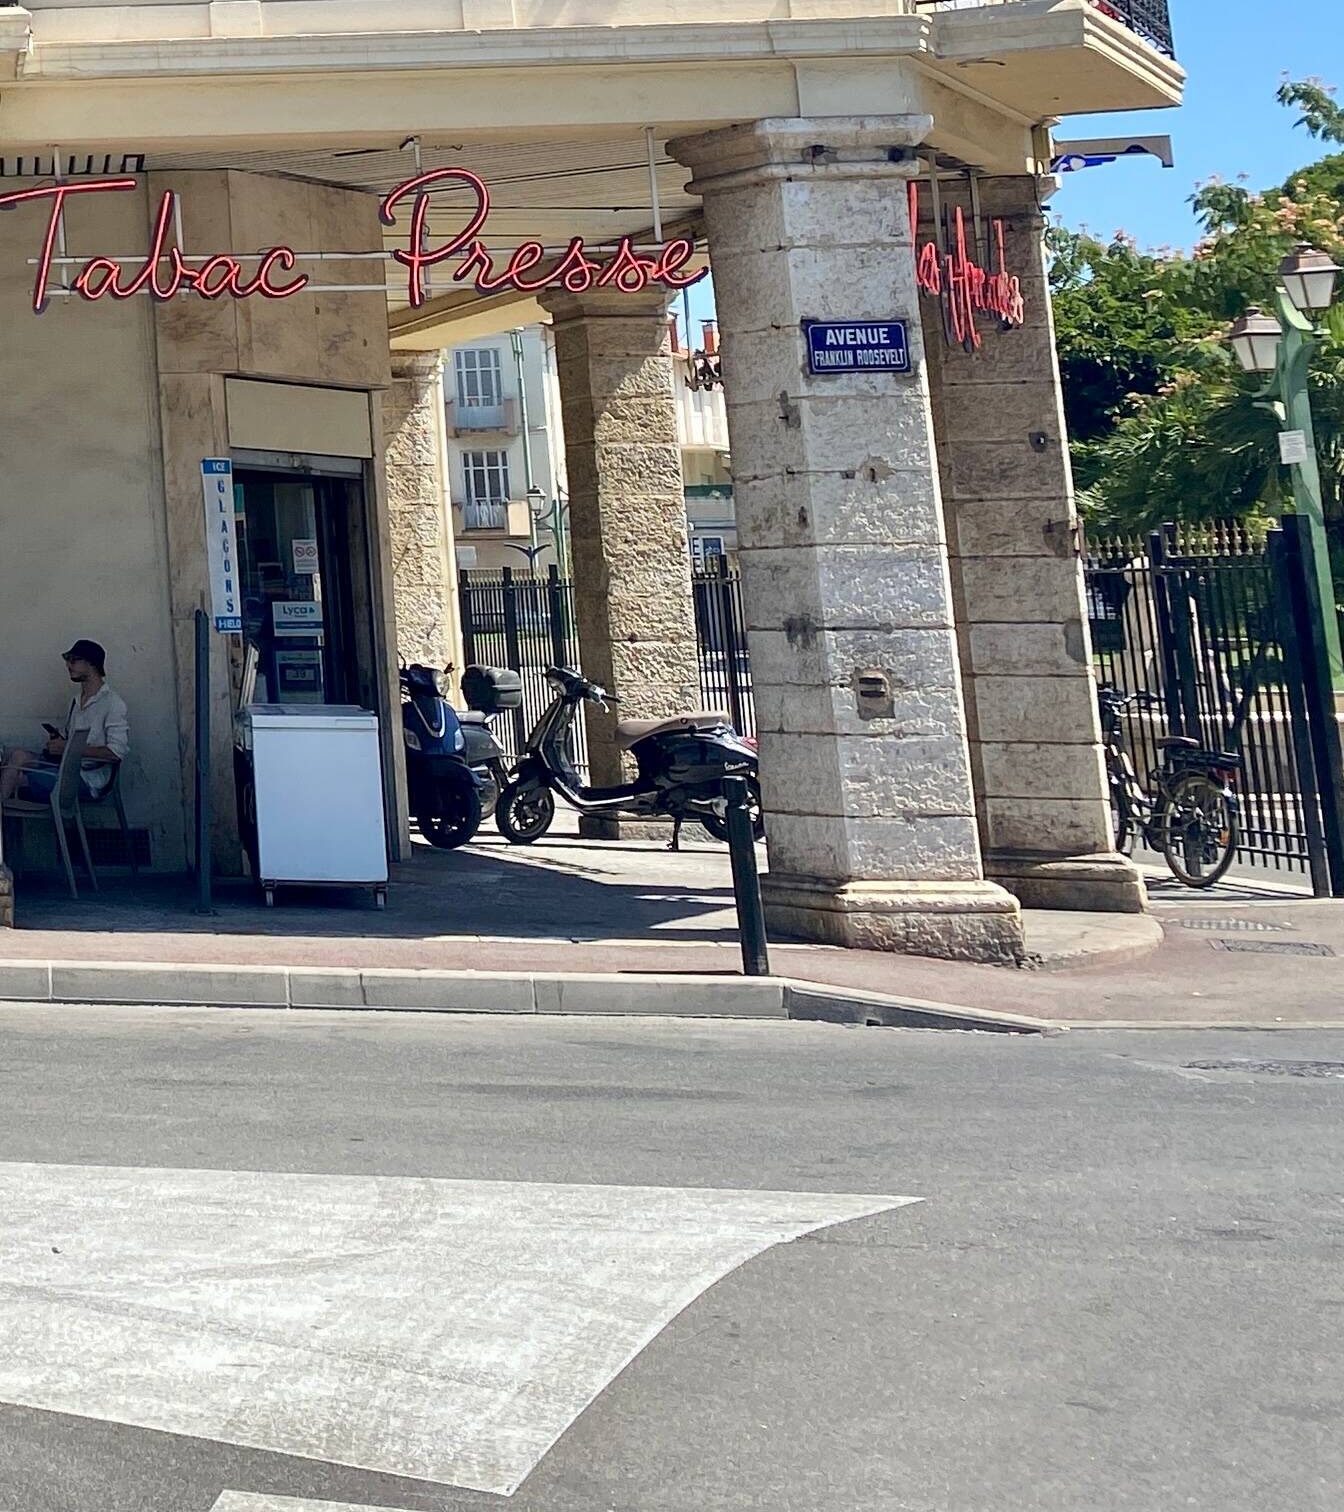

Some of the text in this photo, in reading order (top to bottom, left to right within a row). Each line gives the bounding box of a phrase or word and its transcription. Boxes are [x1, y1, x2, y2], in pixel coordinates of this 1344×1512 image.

[380, 168, 711, 308] Presse
[825, 327, 890, 346] AVENUE
[814, 348, 904, 366] FRANKLIN ROOSEVELT
[212, 462, 226, 472] ICE
[282, 605, 308, 616] Lyca
